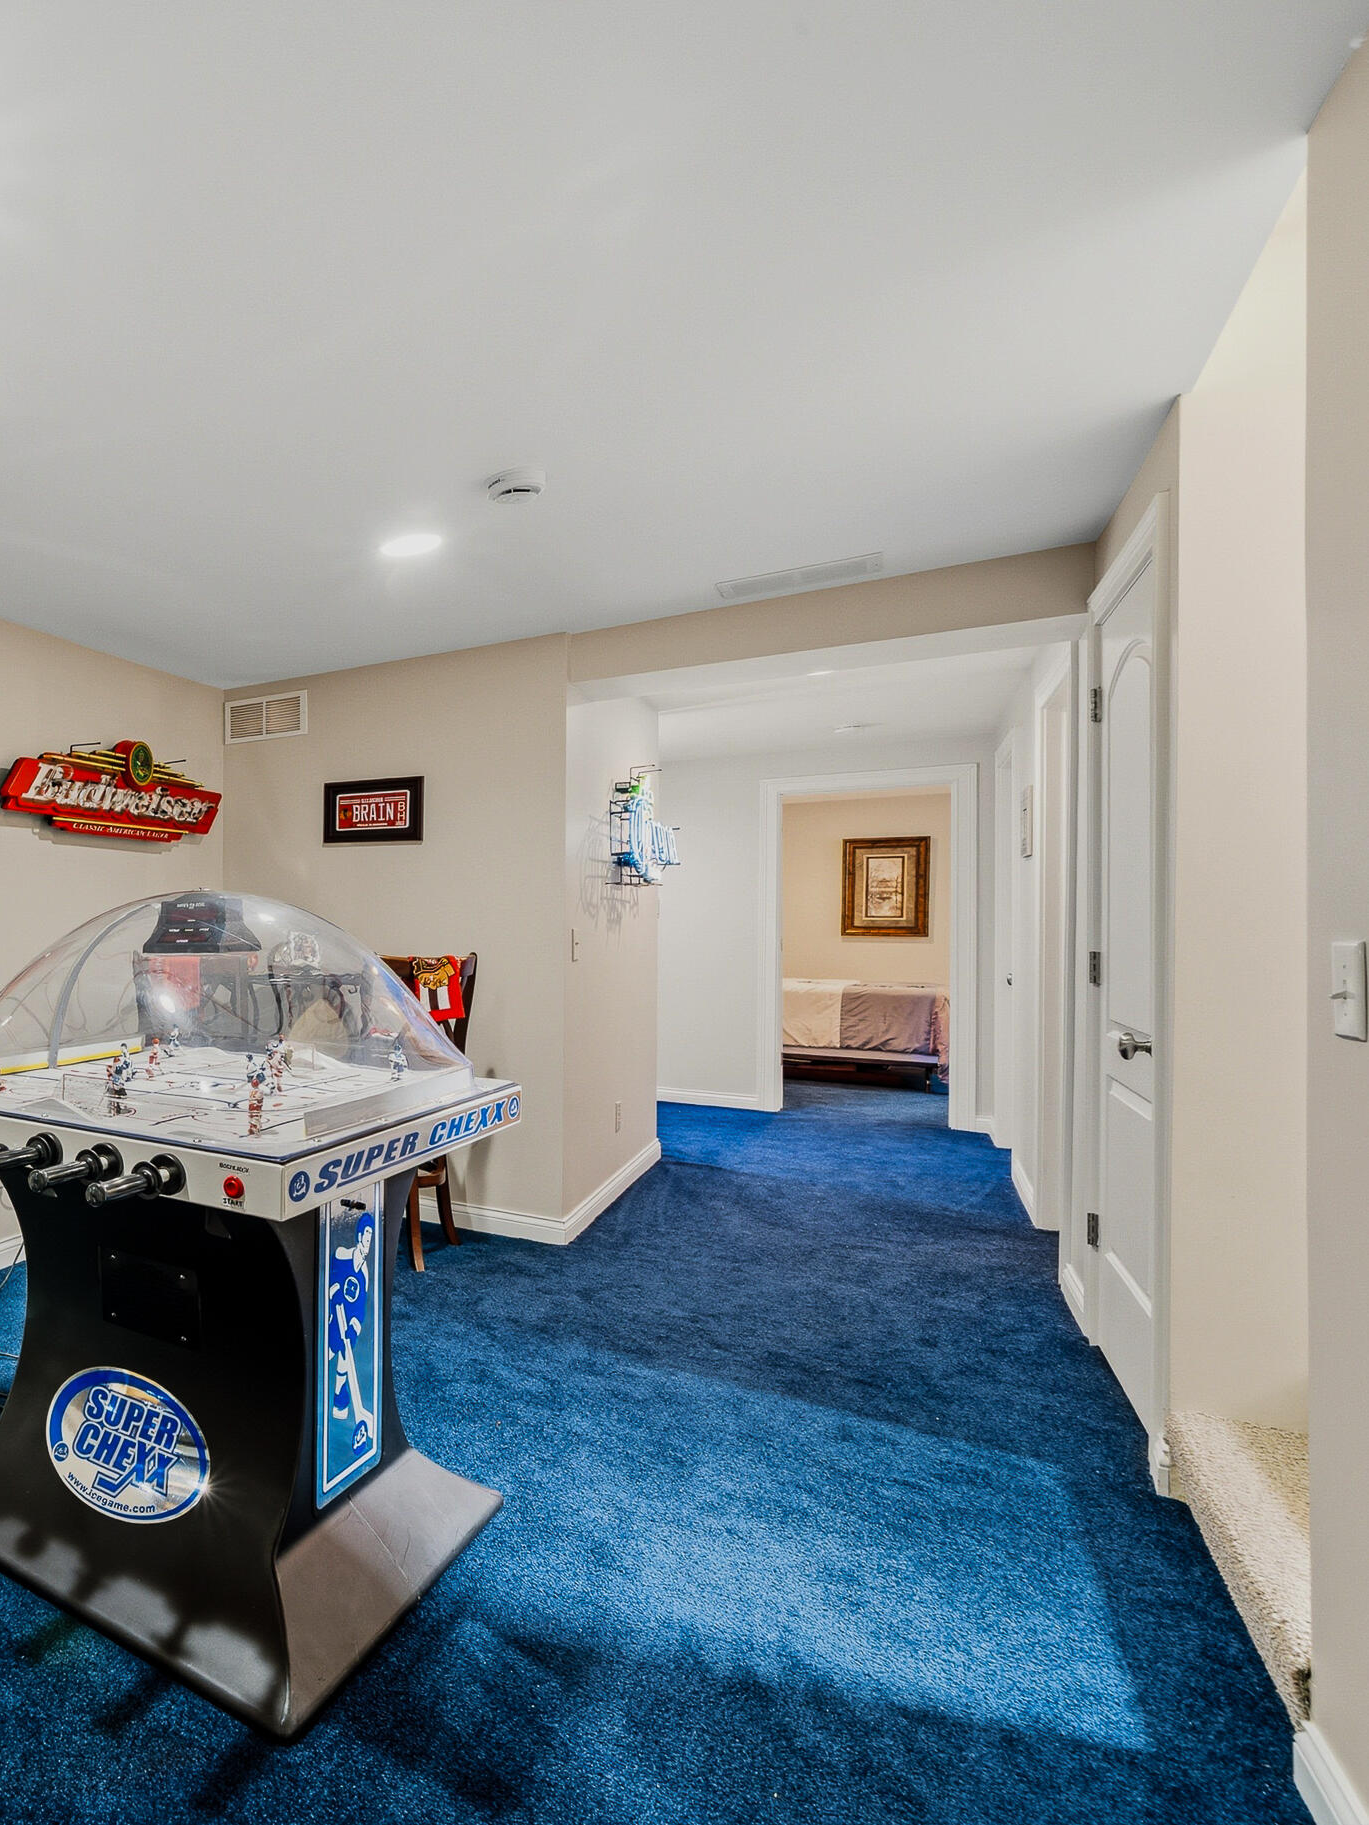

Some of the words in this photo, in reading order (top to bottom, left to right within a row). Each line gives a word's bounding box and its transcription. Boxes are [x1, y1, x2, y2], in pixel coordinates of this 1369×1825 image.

[22, 763, 215, 822] Budweiser
[352, 803, 394, 822] BRAIN
[72, 822, 105, 832] CLASSIC
[107, 826, 146, 837] AMERICAN
[313, 1131, 420, 1193] SUPER
[428, 1099, 507, 1146] CHEXX
[84, 1385, 181, 1451] SUPER
[73, 1421, 179, 1497] CHEXX
[67, 1471, 156, 1513] www.icegame.com
